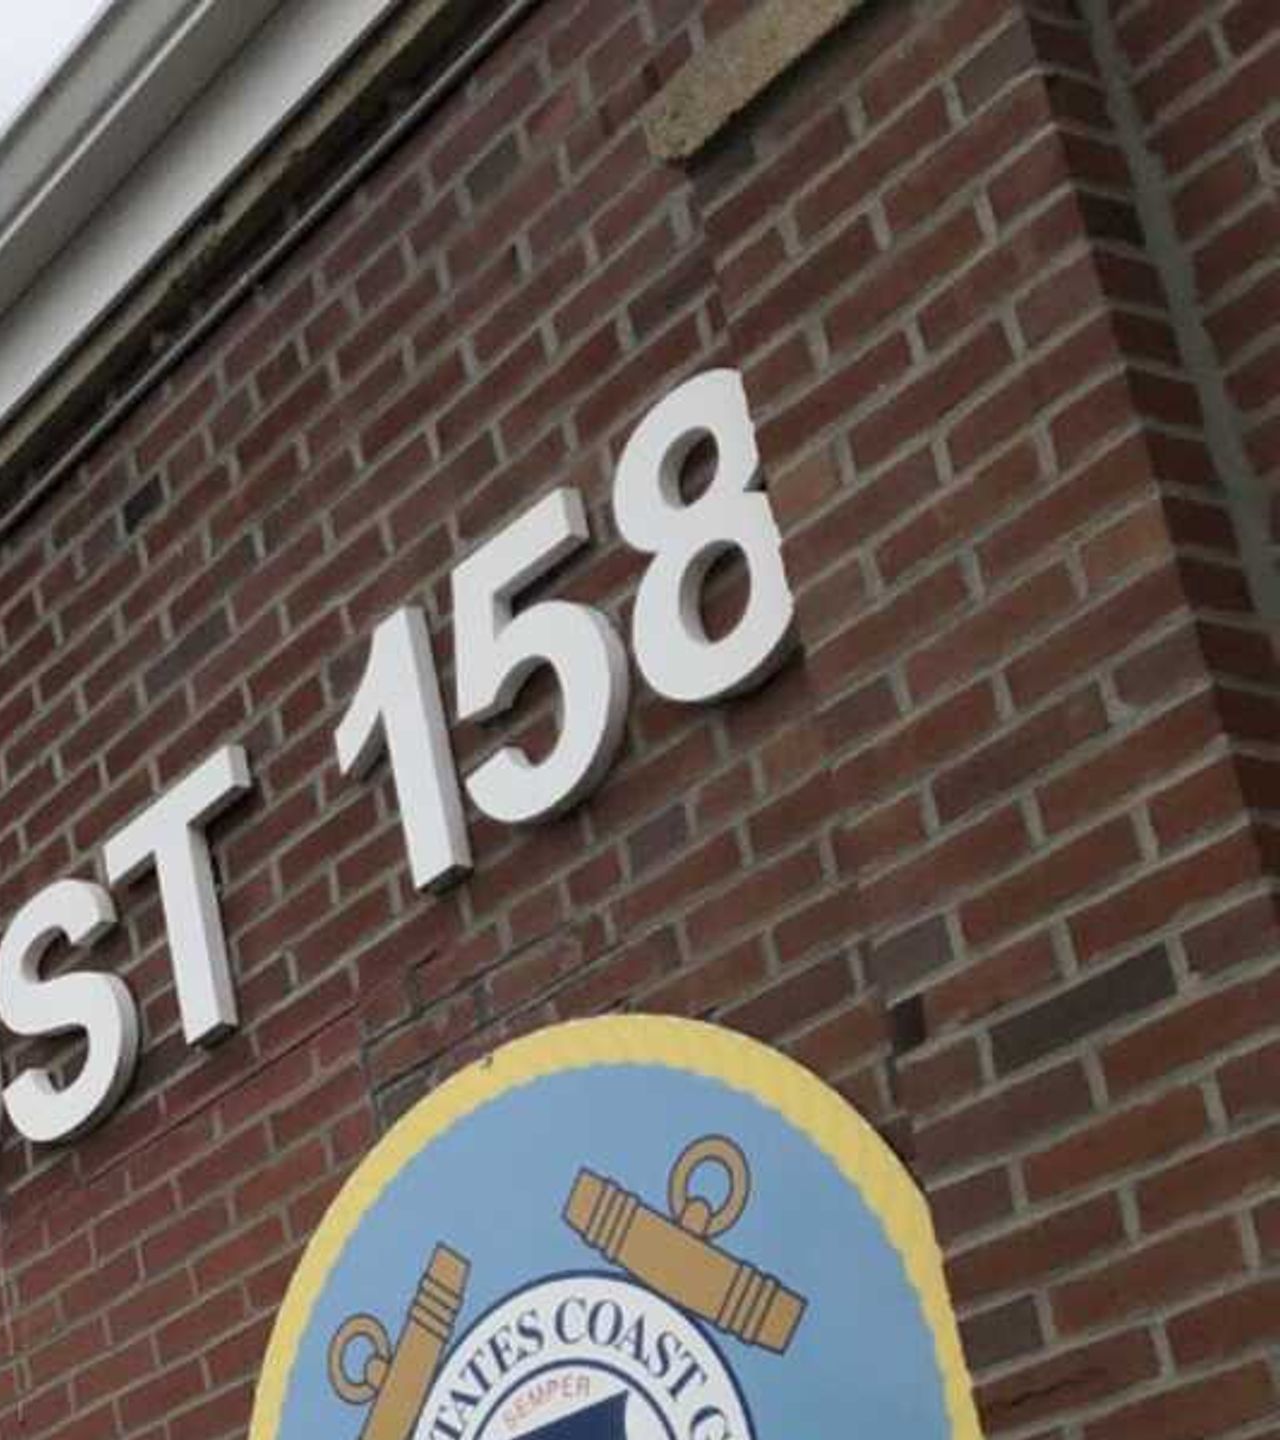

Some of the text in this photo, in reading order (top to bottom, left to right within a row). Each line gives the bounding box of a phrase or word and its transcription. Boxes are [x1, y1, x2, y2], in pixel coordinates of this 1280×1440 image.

[334, 367, 794, 891] 158
[503, 1374, 591, 1429] SEMPER
[554, 1297, 706, 1402] COAST
